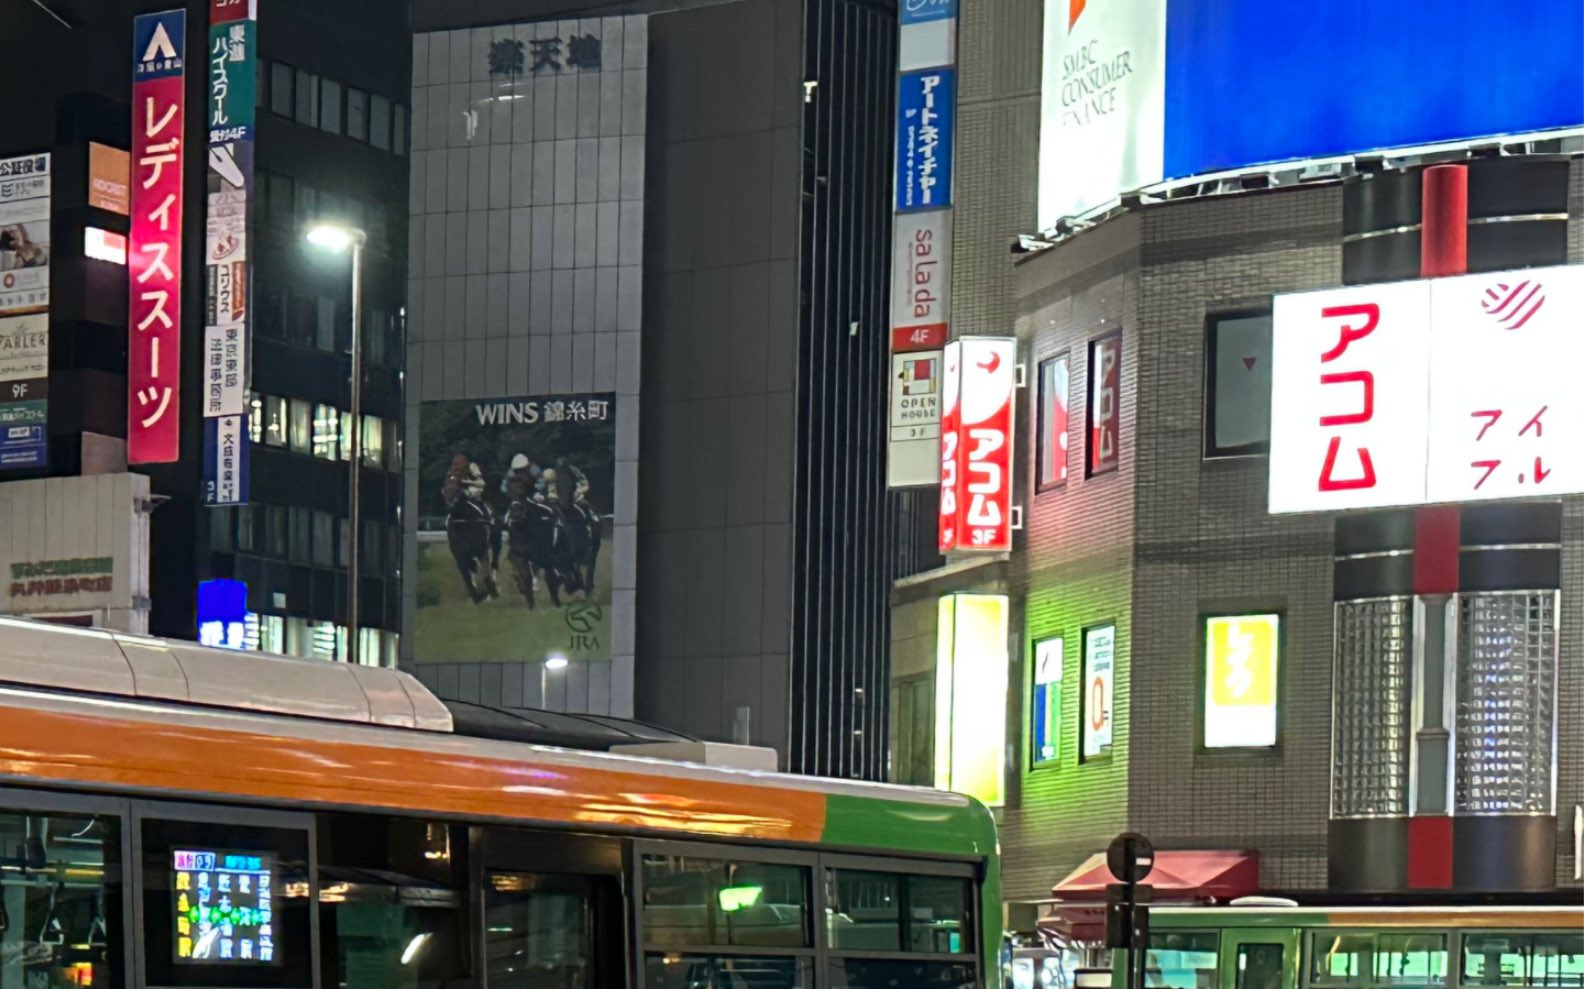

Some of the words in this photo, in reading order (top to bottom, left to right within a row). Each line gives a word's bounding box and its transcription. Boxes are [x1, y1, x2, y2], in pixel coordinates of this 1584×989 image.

[212, 37, 228, 126] ハイスクール
[918, 76, 940, 204] アートネイチャー
[137, 97, 179, 428] レディススーツ
[914, 229, 938, 318] salada
[12, 384, 28, 398] 9F
[475, 402, 539, 425] WINS
[901, 397, 936, 408] OPEN
[901, 408, 936, 420] HOUSE
[1318, 303, 1380, 492] アコム
[967, 428, 1004, 526] アコム
[971, 529, 996, 545] 3F
